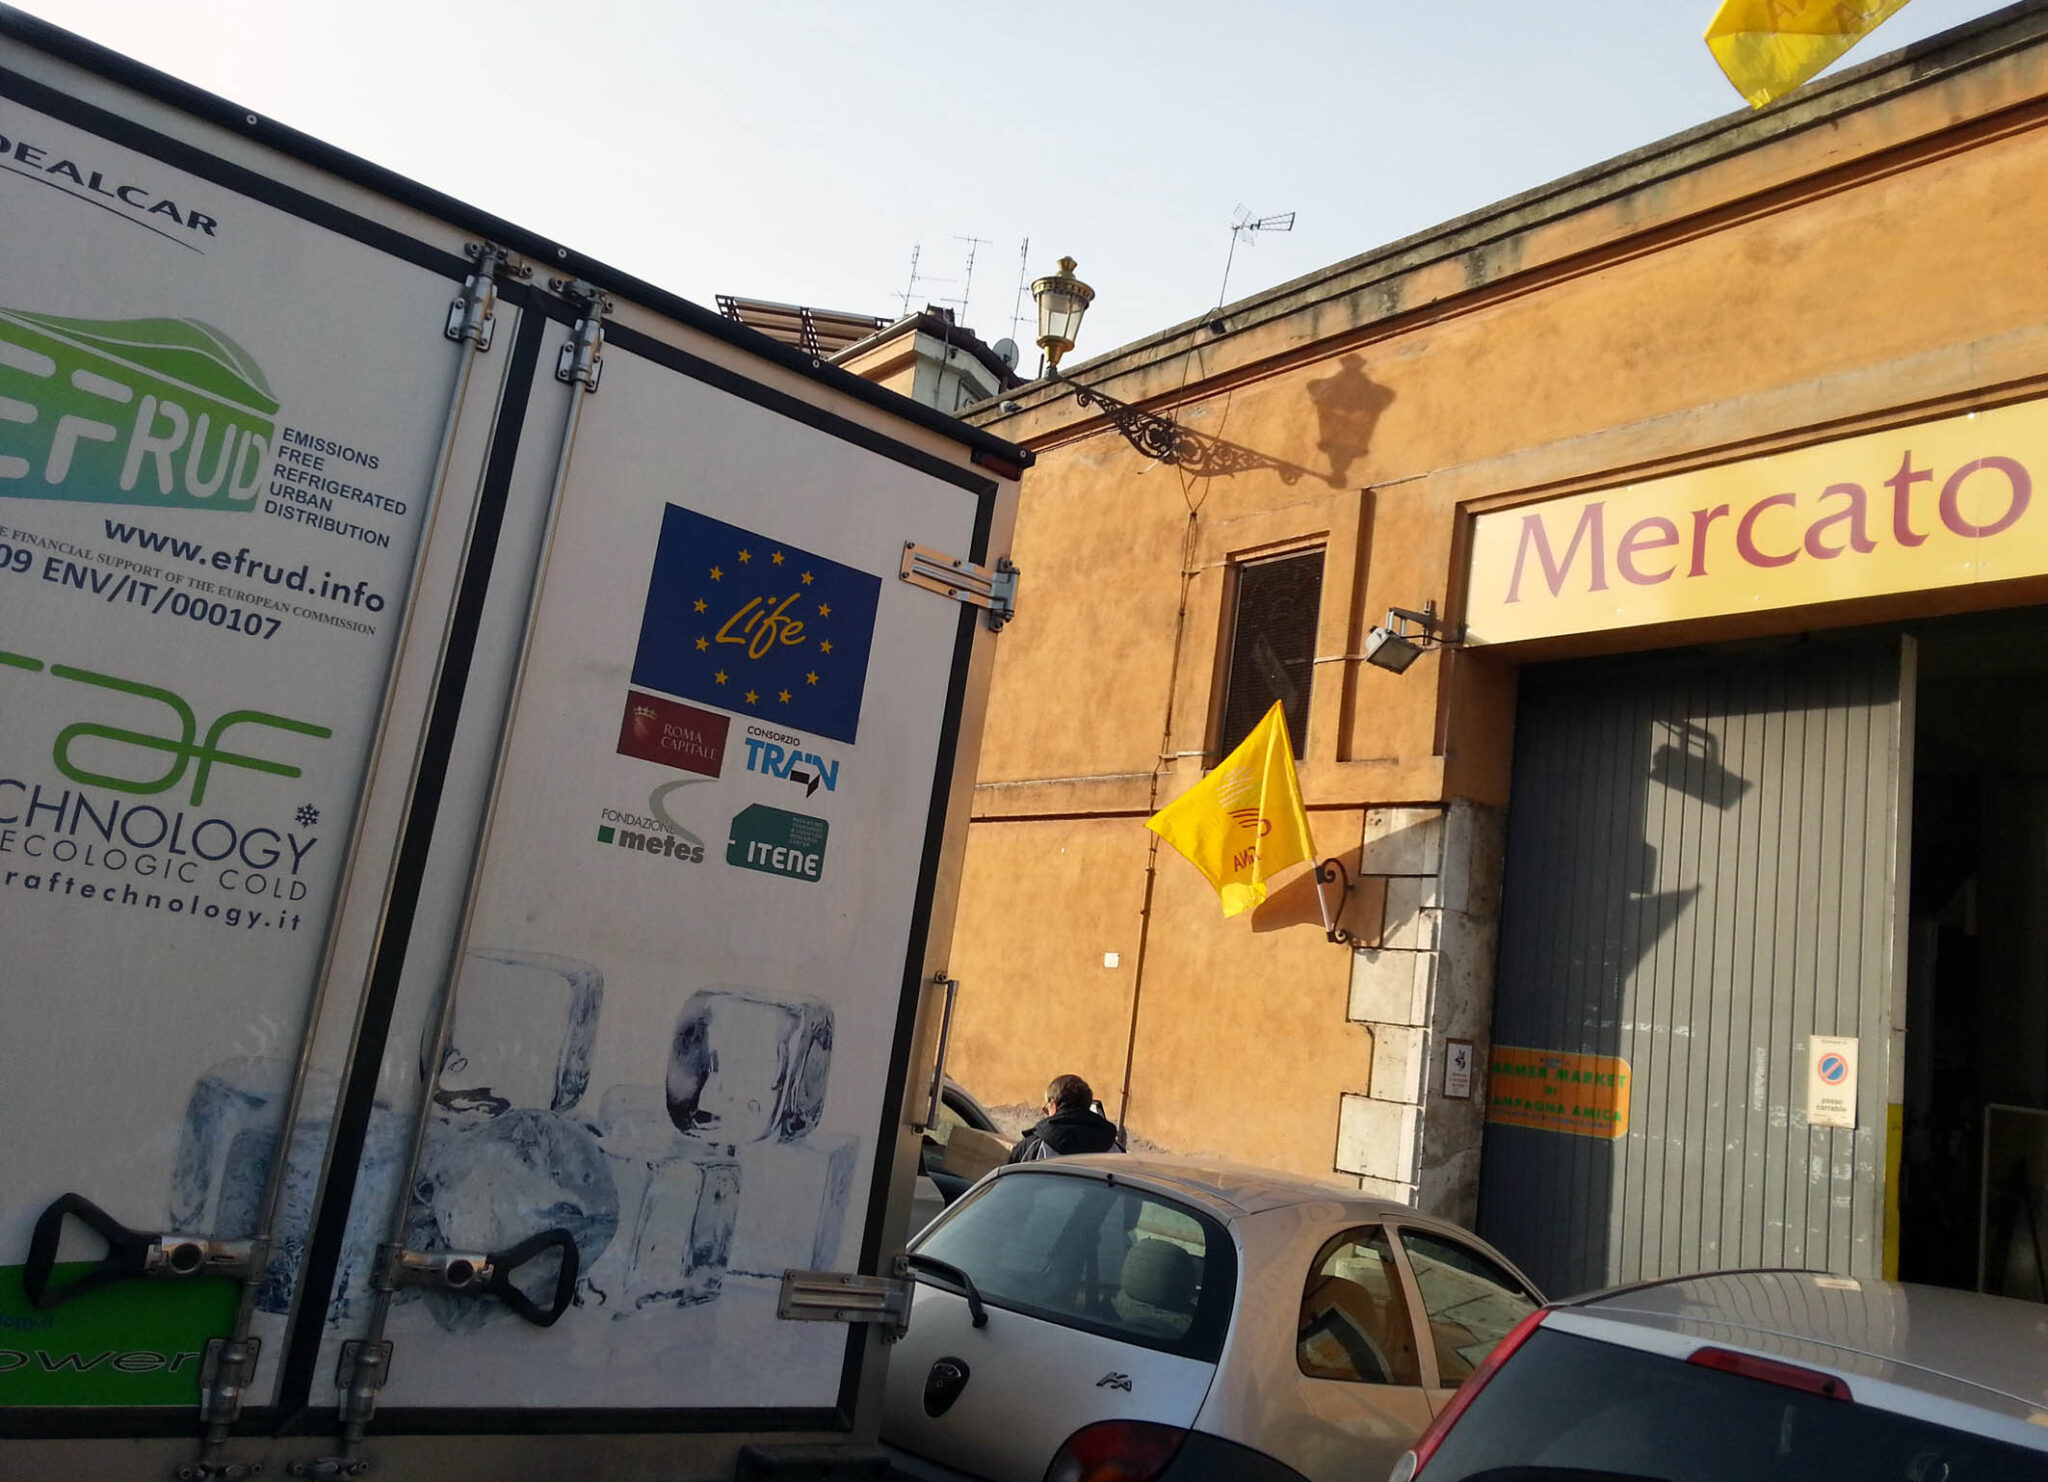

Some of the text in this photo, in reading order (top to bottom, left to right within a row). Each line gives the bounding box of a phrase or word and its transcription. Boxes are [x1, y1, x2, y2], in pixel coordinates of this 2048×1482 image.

[0, 134, 218, 237] EALCAR
[278, 445, 326, 472] FREE
[283, 427, 380, 470] EMISSIONS
[269, 481, 333, 512] URBAN
[273, 463, 407, 516] REFRIGERATED
[264, 500, 390, 549] DISTRIBUTION
[1503, 450, 2033, 605] Mercato
[12, 529, 94, 561] FINANCIAL
[97, 553, 163, 578] SUPPORT
[165, 571, 186, 584] OF
[187, 577, 216, 594] THE
[218, 586, 291, 613] EUROPEAN
[293, 605, 377, 637] COMMISSION
[105, 519, 385, 613] www.efrud.info
[42, 556, 282, 640] ENV/IT/000107
[715, 592, 807, 660] Life
[660, 736, 718, 761] CAPITALE
[663, 723, 703, 744] ROMA
[746, 725, 801, 747] CONSORZIO
[601, 808, 676, 834] FONDAZIONE
[0, 830, 307, 901] ECOLOGIC COLD
[618, 828, 705, 864] metes
[747, 840, 820, 876] ITENE
[5, 871, 302, 931] raftechnology.it
[1492, 1061, 1548, 1080] ARMER
[1555, 1068, 1627, 1089] MARKET
[1571, 1105, 1622, 1123] AMICA
